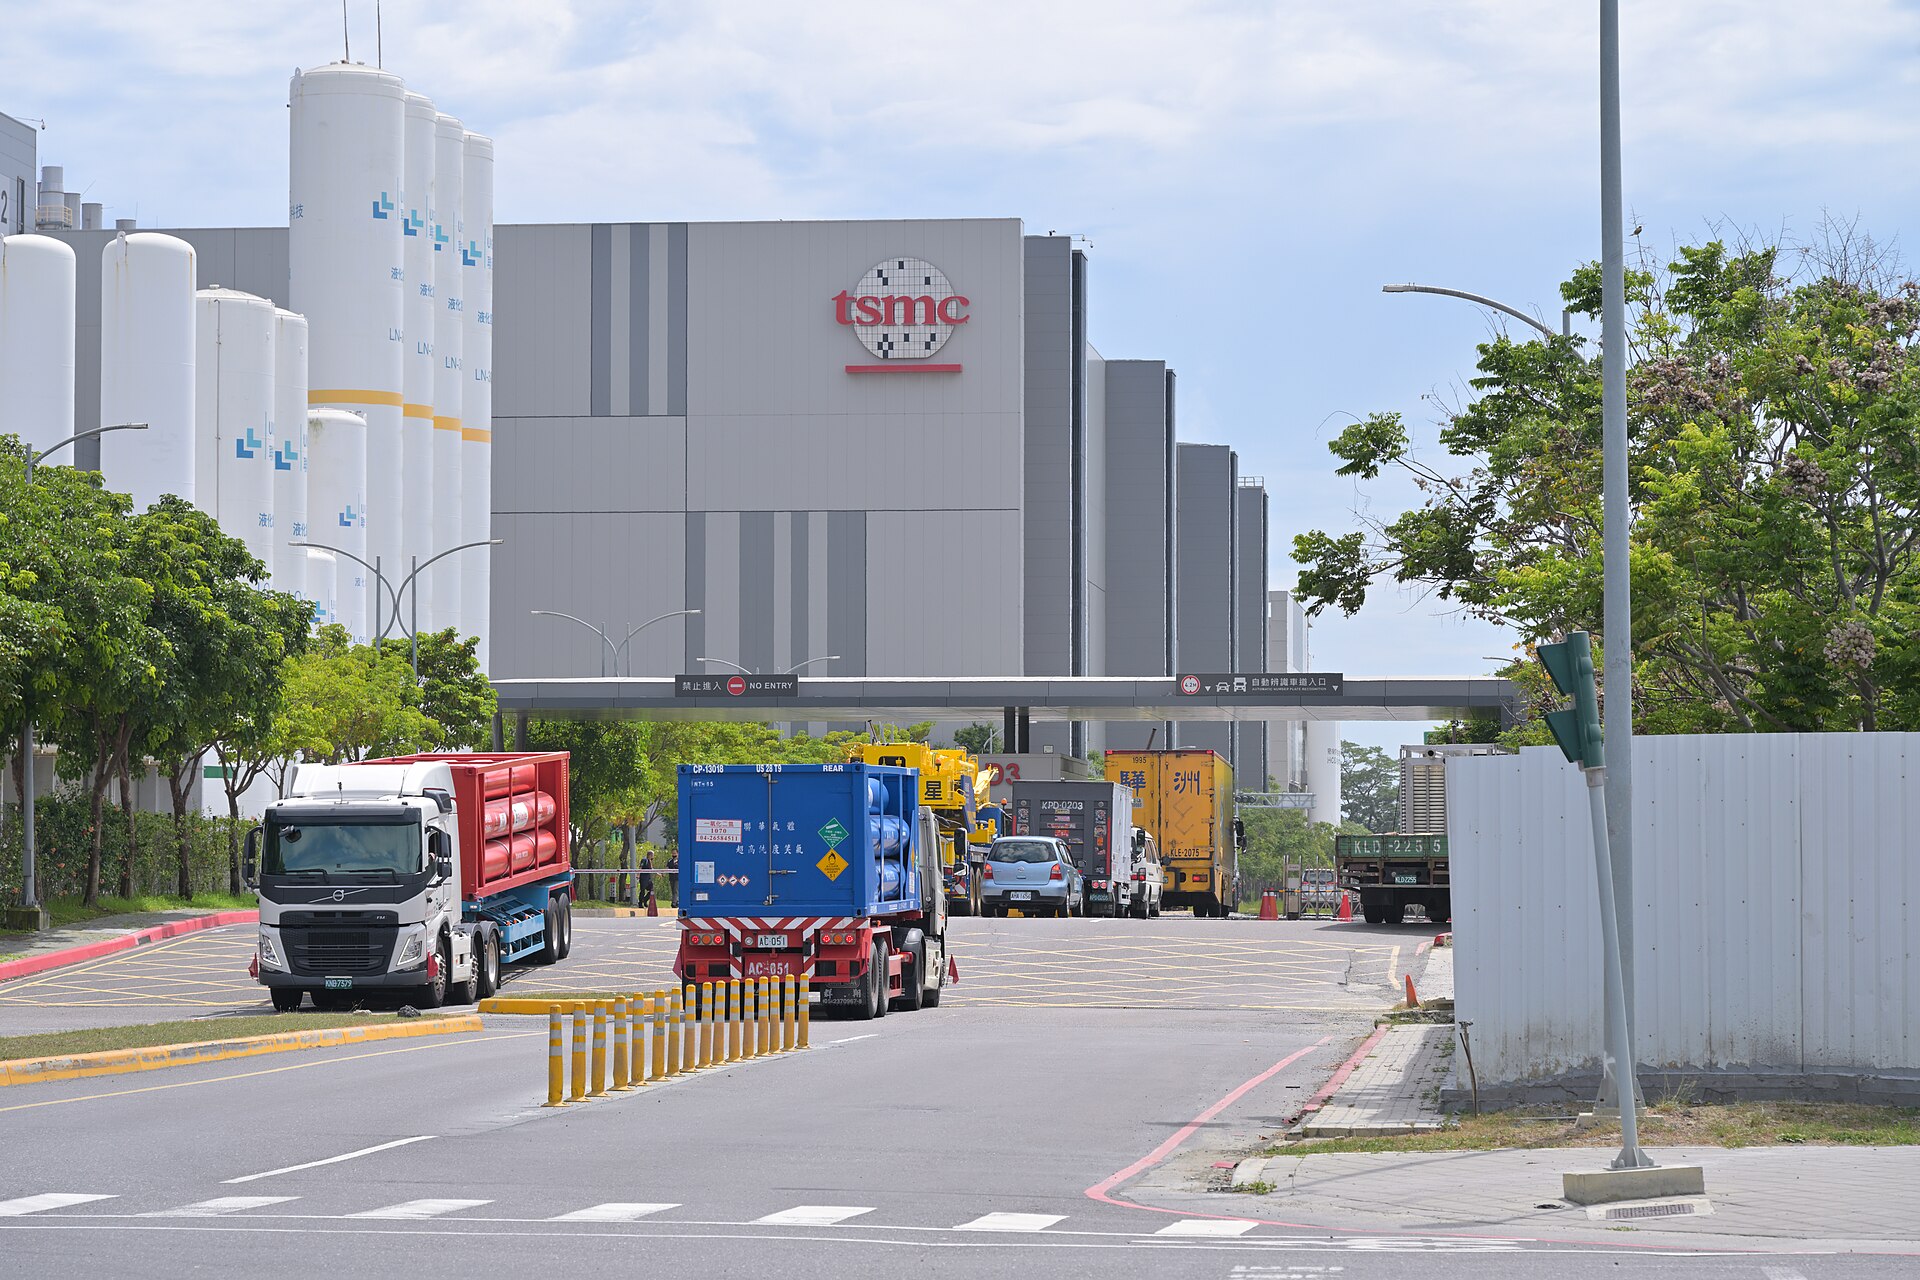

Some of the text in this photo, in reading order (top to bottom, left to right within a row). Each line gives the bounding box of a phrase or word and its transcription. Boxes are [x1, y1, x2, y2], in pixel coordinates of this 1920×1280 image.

[831, 289, 971, 326] tsmc
[682, 681, 722, 691] 禁止進入
[1252, 678, 1326, 687] 自動辨識車道入口
[1132, 756, 1147, 764] 1995
[693, 764, 724, 774] CP-13018
[924, 780, 943, 801] 星
[1041, 801, 1084, 810] KPD-0203
[1354, 839, 1441, 854] KLD-2255
[1170, 848, 1200, 857] KLE-2075
[748, 961, 789, 975] AC-051
